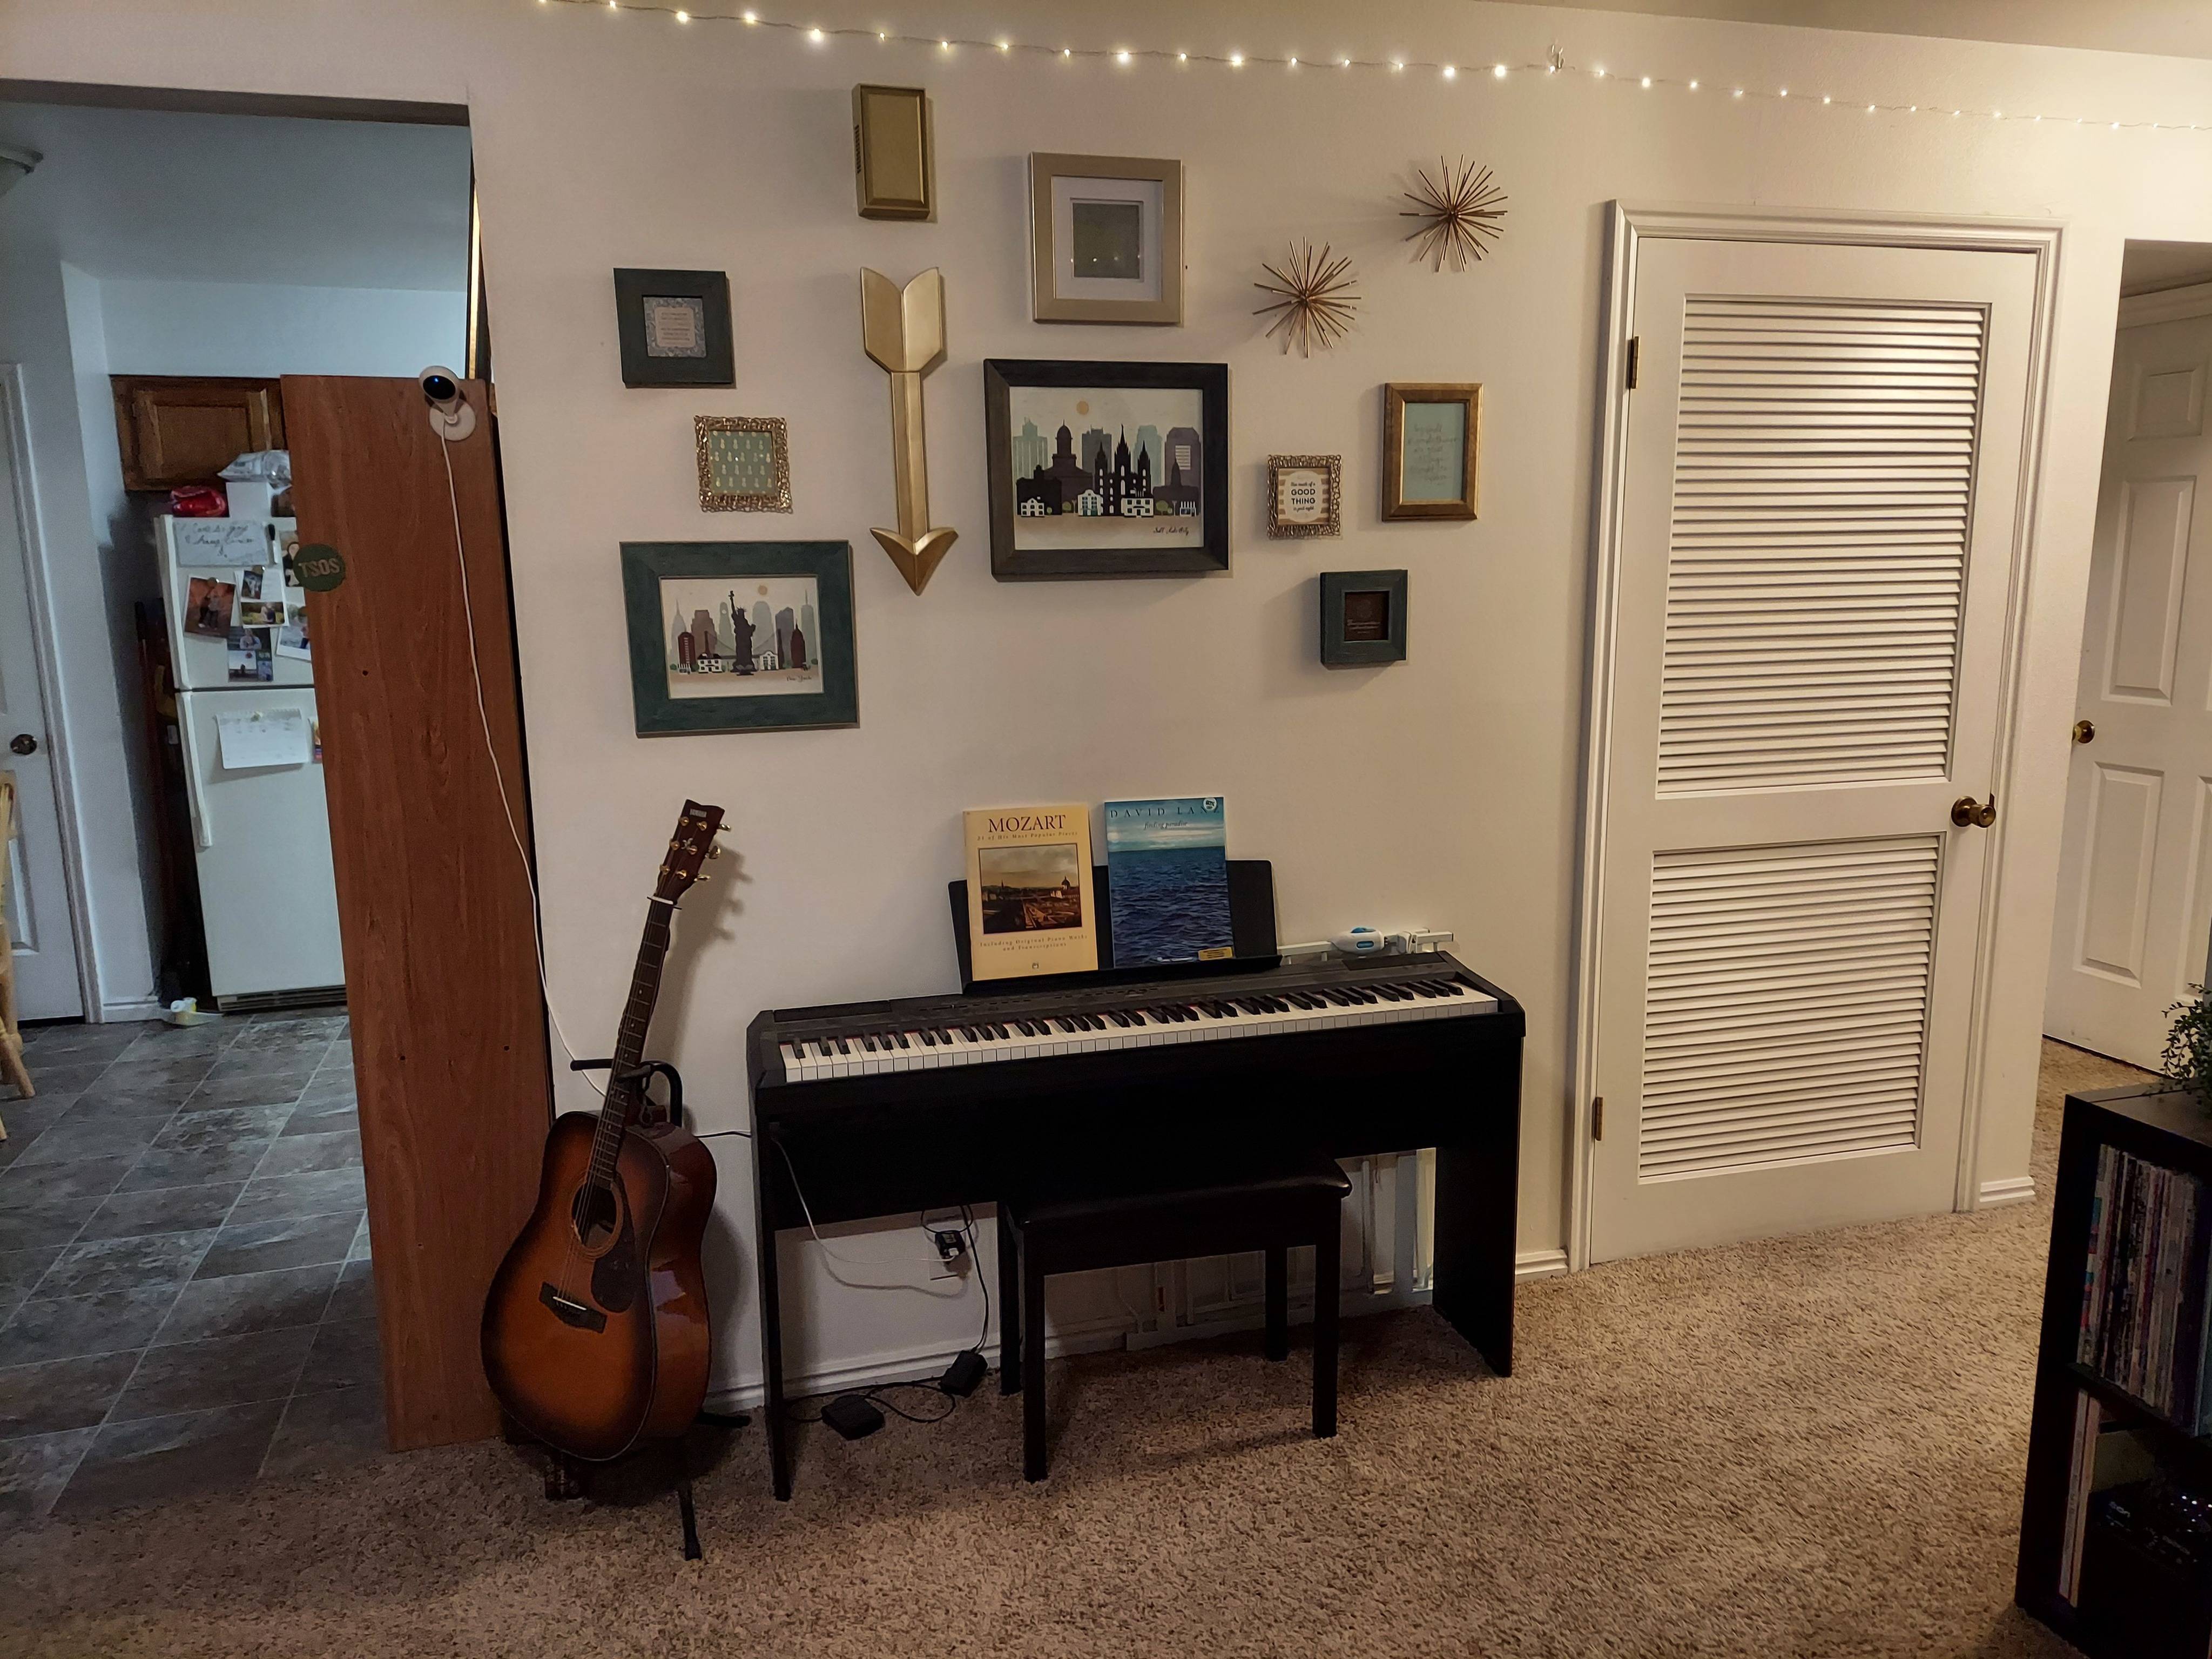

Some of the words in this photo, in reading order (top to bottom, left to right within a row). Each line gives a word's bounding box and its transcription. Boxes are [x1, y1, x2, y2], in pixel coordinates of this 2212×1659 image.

[298, 558, 340, 577] TSOS
[1110, 807, 1165, 818] DAVID
[989, 814, 1066, 833] MOZART
